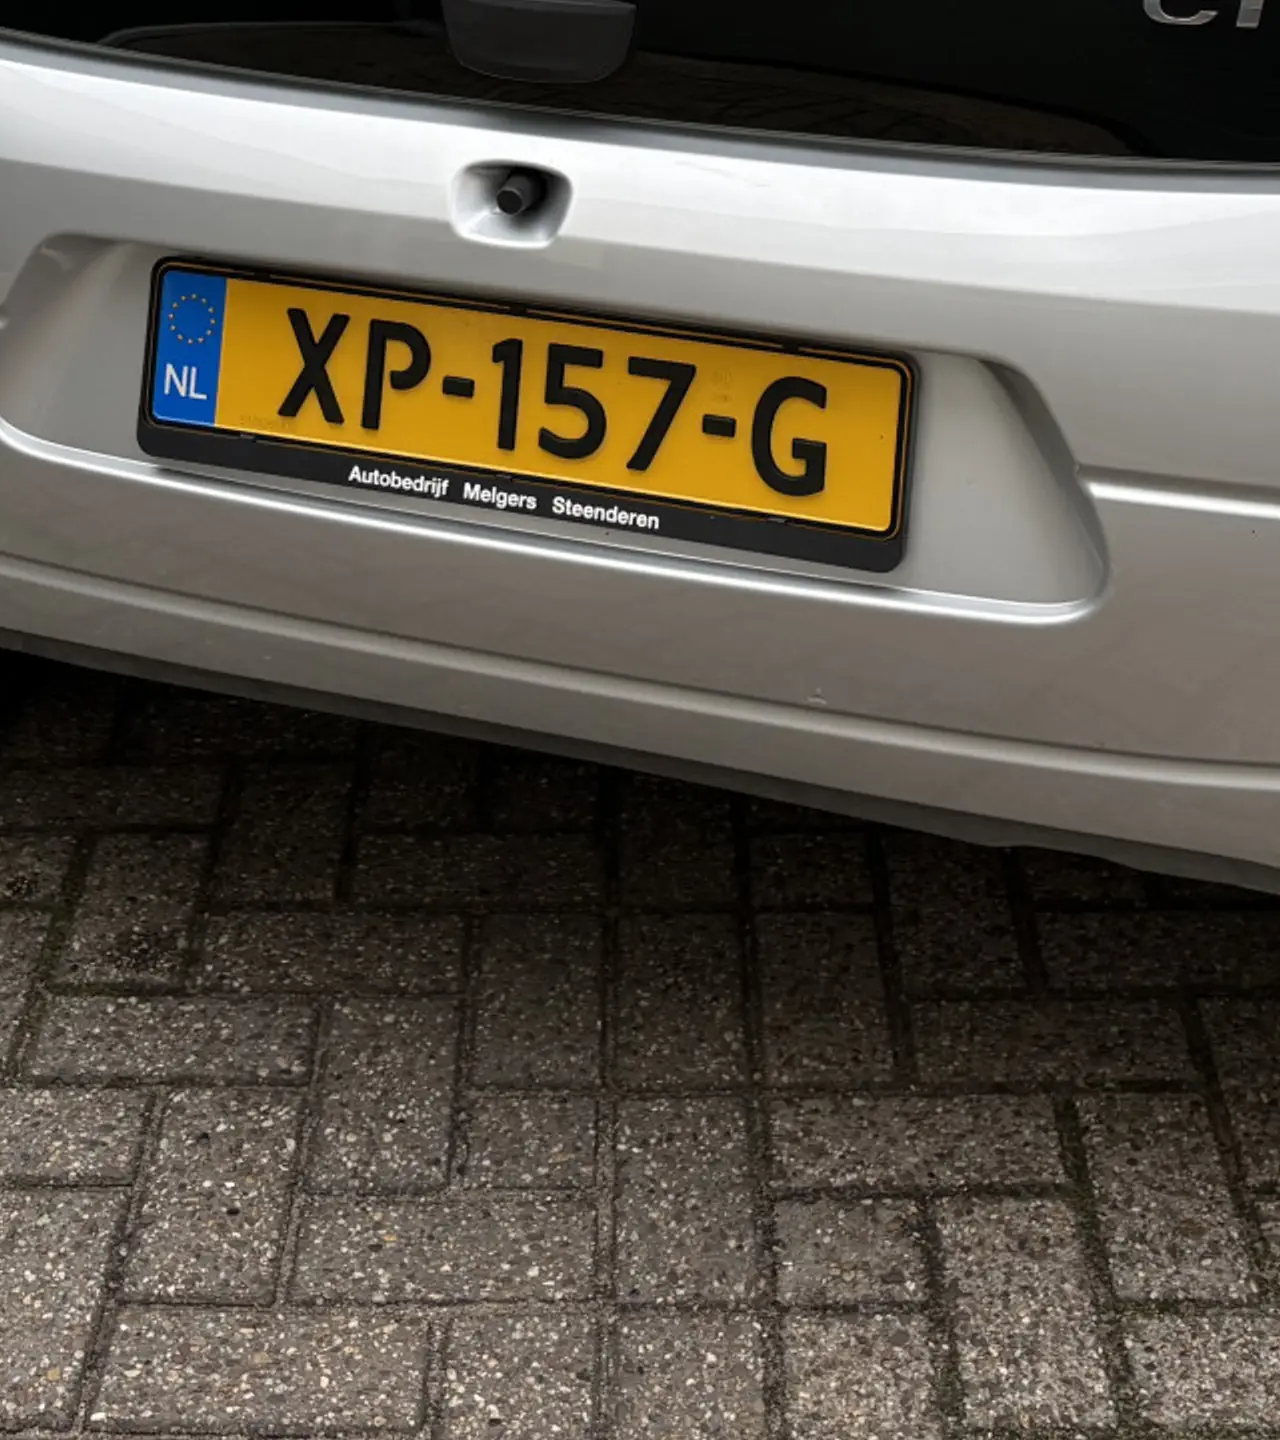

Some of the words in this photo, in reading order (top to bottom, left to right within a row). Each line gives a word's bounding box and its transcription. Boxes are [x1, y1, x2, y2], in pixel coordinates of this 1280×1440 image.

[163, 363, 207, 401] NL
[277, 306, 828, 497] XP-157-G
[348, 465, 449, 498] Autobedrijf
[463, 482, 537, 512] Melgers
[552, 496, 661, 531] Steenderen
